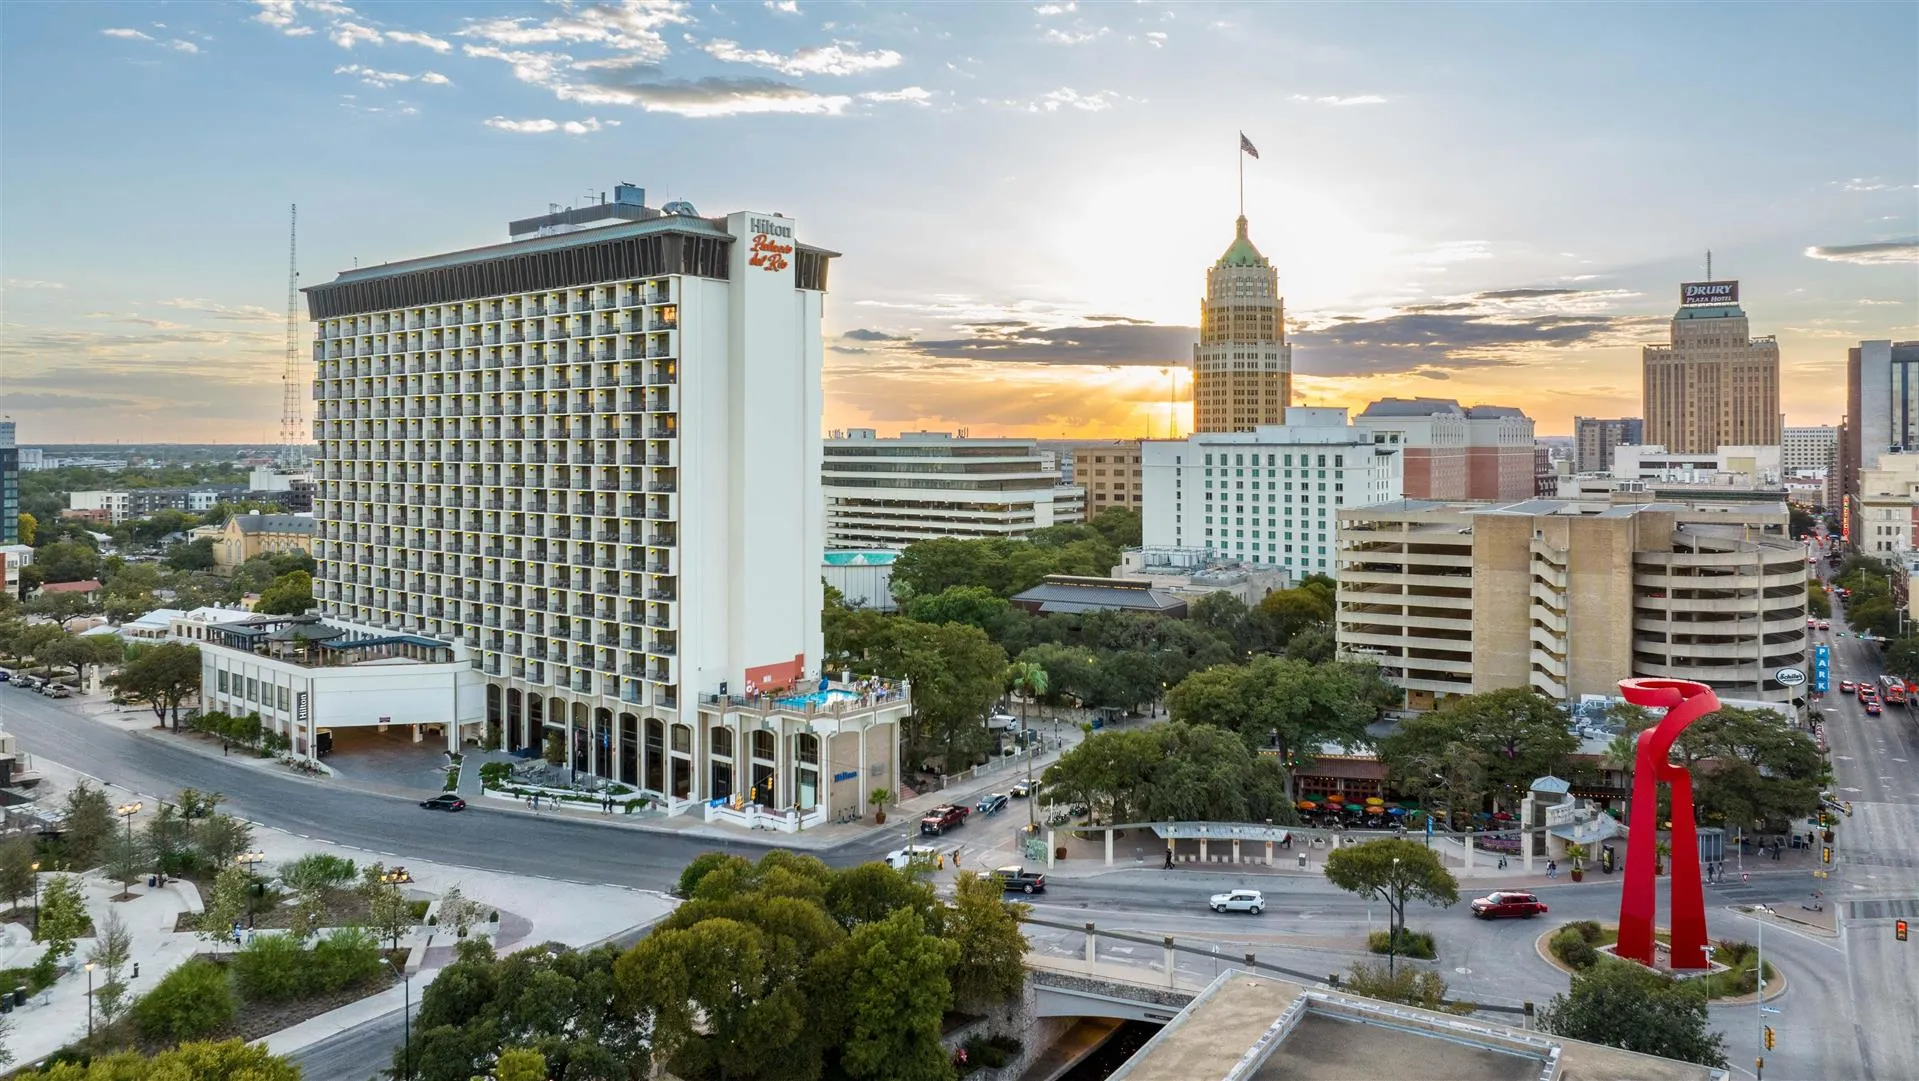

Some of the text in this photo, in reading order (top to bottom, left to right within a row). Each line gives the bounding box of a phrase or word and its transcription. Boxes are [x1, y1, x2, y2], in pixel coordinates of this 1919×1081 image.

[750, 217, 791, 238] Hilton
[1685, 285, 1732, 296] DRURY
[1710, 295, 1732, 303] HOTEL
[1818, 648, 1826, 690] PARK
[299, 694, 307, 719] Hilton
